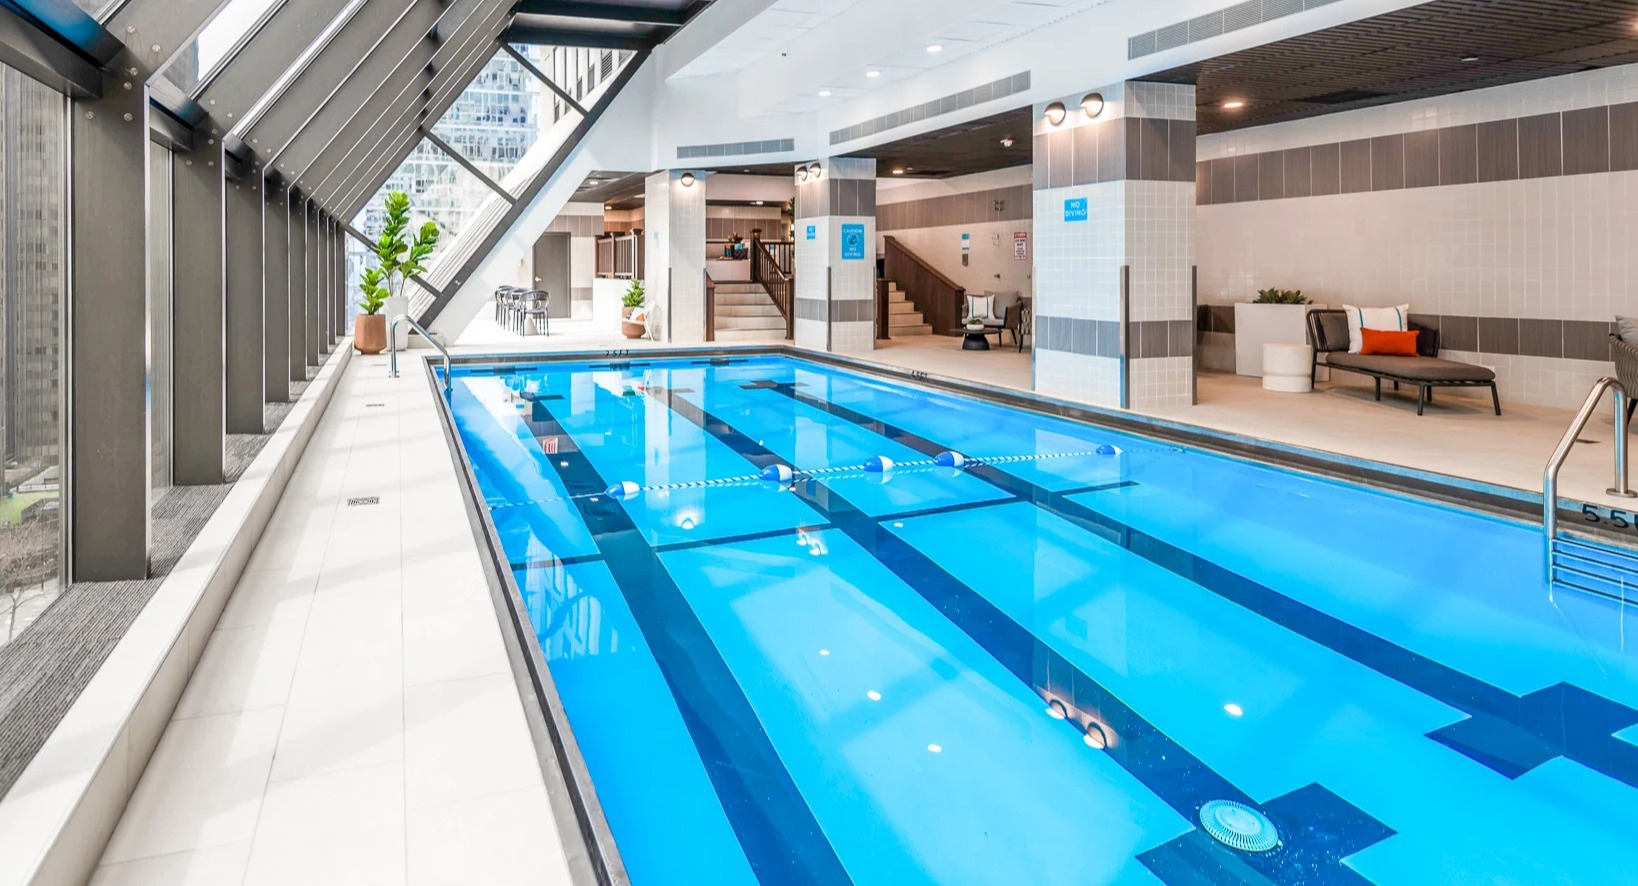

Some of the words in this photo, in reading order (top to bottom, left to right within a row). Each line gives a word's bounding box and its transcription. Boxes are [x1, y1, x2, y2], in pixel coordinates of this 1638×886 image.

[1070, 201, 1080, 209] NO
[1065, 208, 1086, 217] DIVING
[1583, 504, 1638, 532] 5.5
